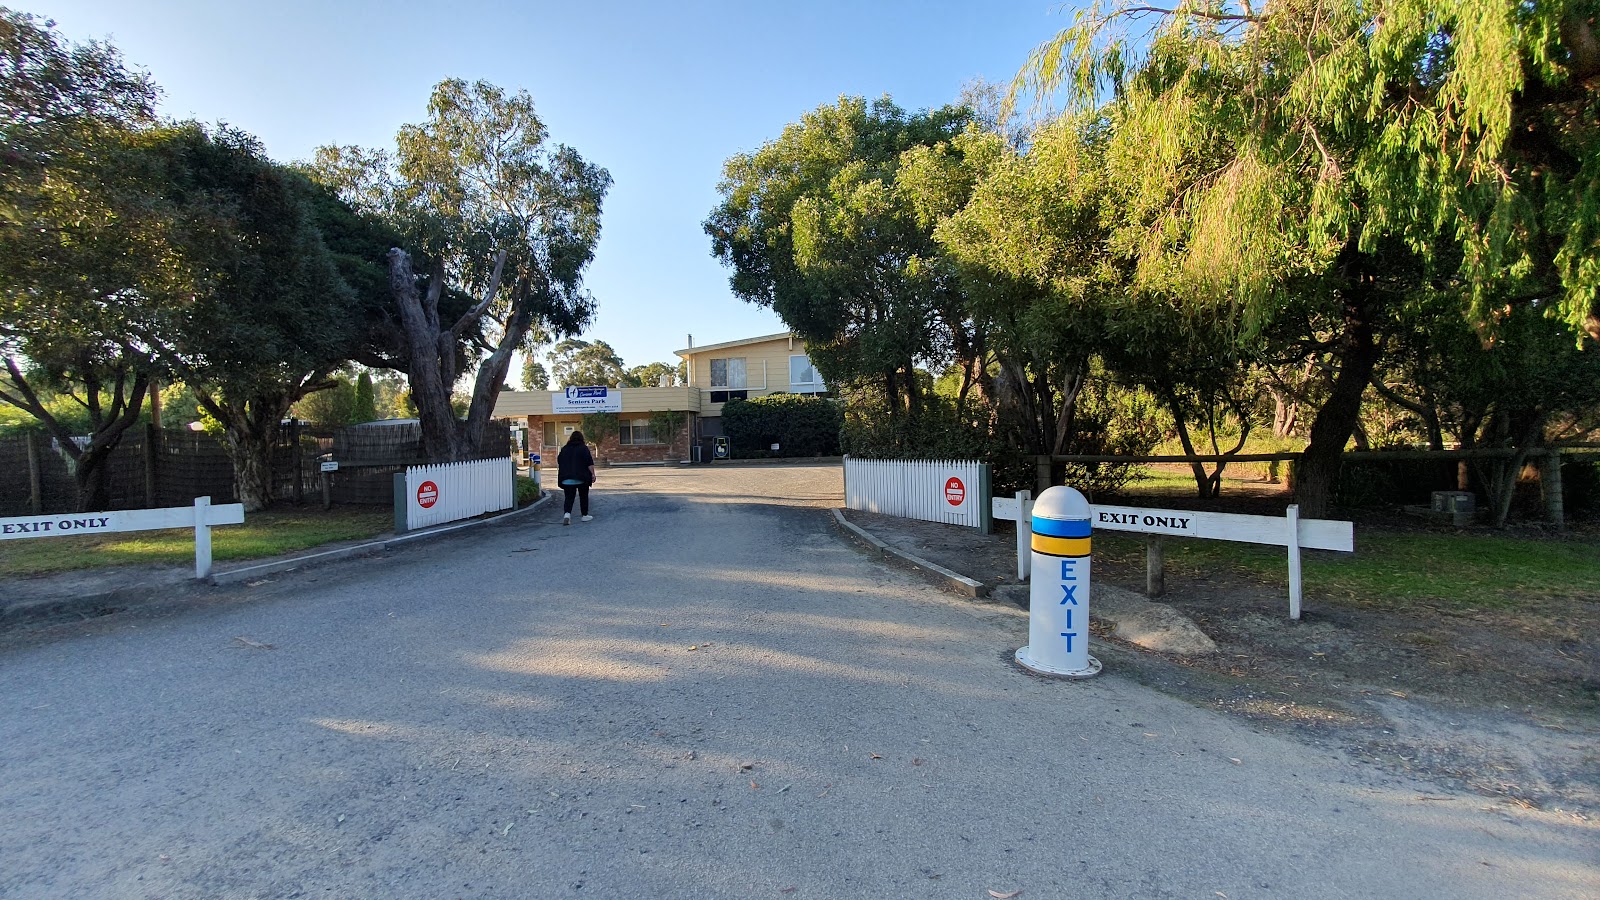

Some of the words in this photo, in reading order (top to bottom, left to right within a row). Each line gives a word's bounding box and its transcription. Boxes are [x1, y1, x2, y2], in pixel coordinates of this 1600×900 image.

[419, 496, 436, 505] ENTRY
[946, 494, 963, 502] ENTRY
[2, 521, 54, 534] EXIT
[58, 517, 110, 530] ONLY
[1098, 512, 1139, 525] EXIT
[1142, 515, 1190, 529] ONLY
[1059, 560, 1078, 653] EXIT
